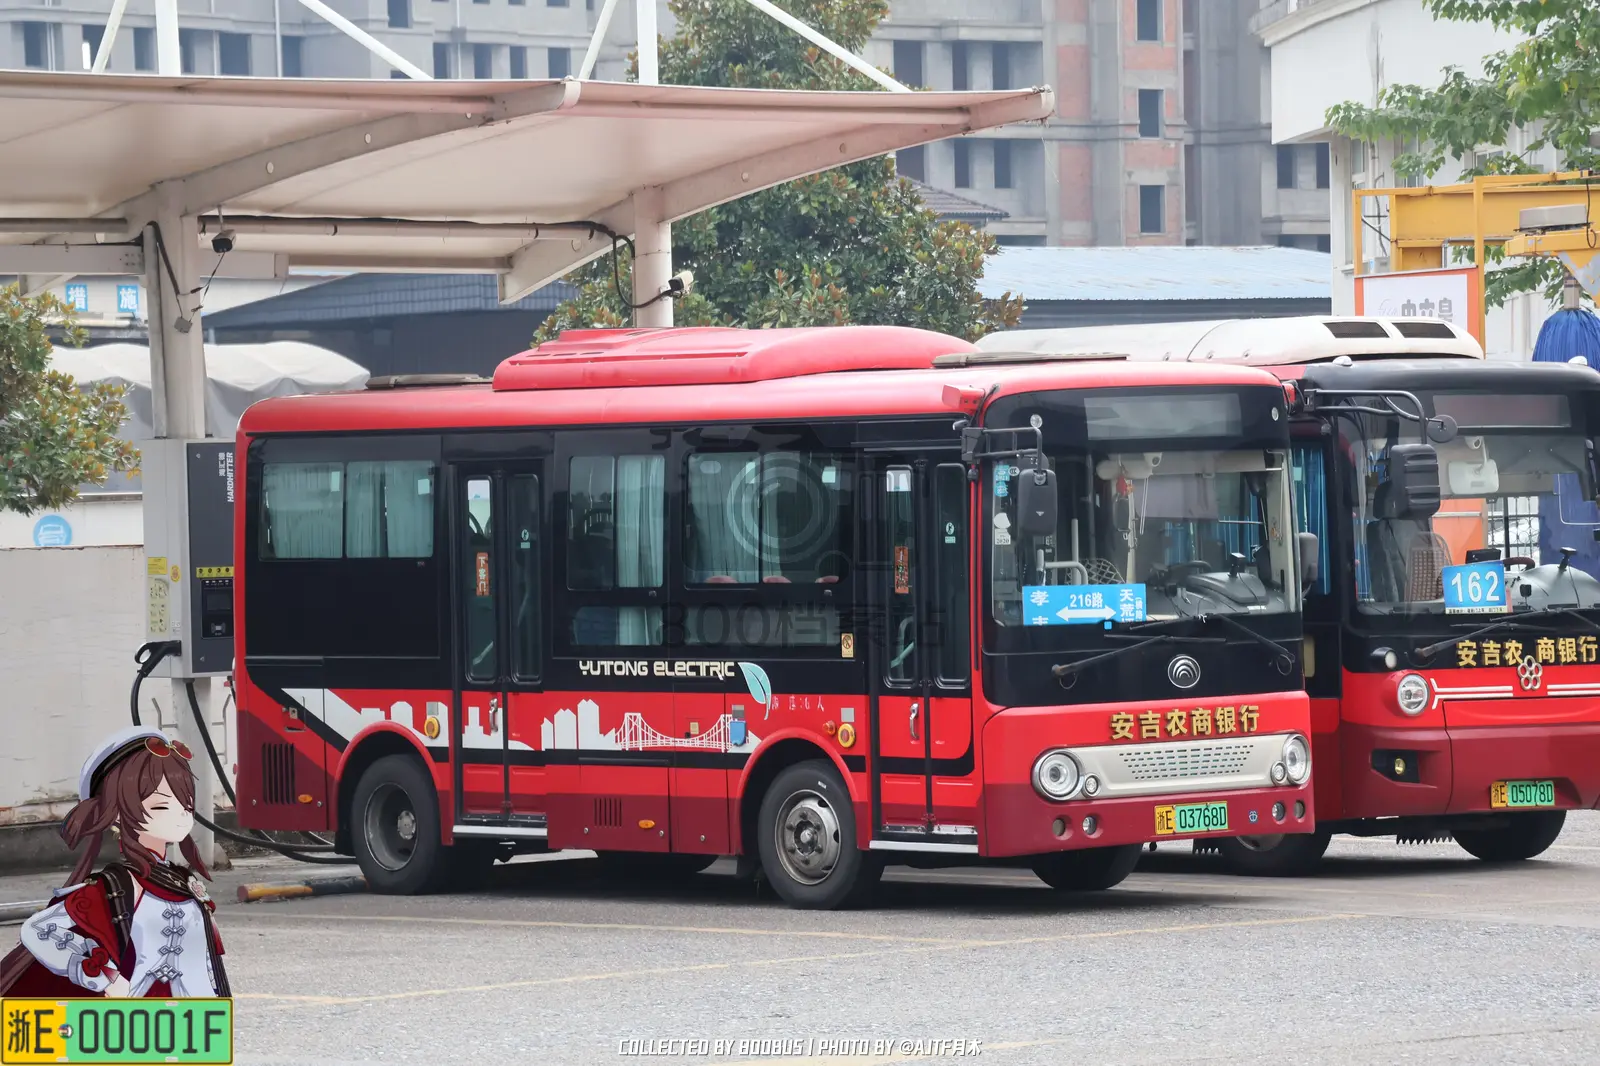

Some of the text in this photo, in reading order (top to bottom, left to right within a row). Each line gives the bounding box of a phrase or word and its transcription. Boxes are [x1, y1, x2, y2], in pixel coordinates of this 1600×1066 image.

[226, 451, 235, 503] HARDHITTER
[1069, 592, 1103, 609] 216路
[1451, 570, 1500, 603] 162
[1457, 635, 1598, 667] 安吉农商银行
[578, 660, 649, 676] YUTONG
[1111, 705, 1260, 740] 安吉农商银行
